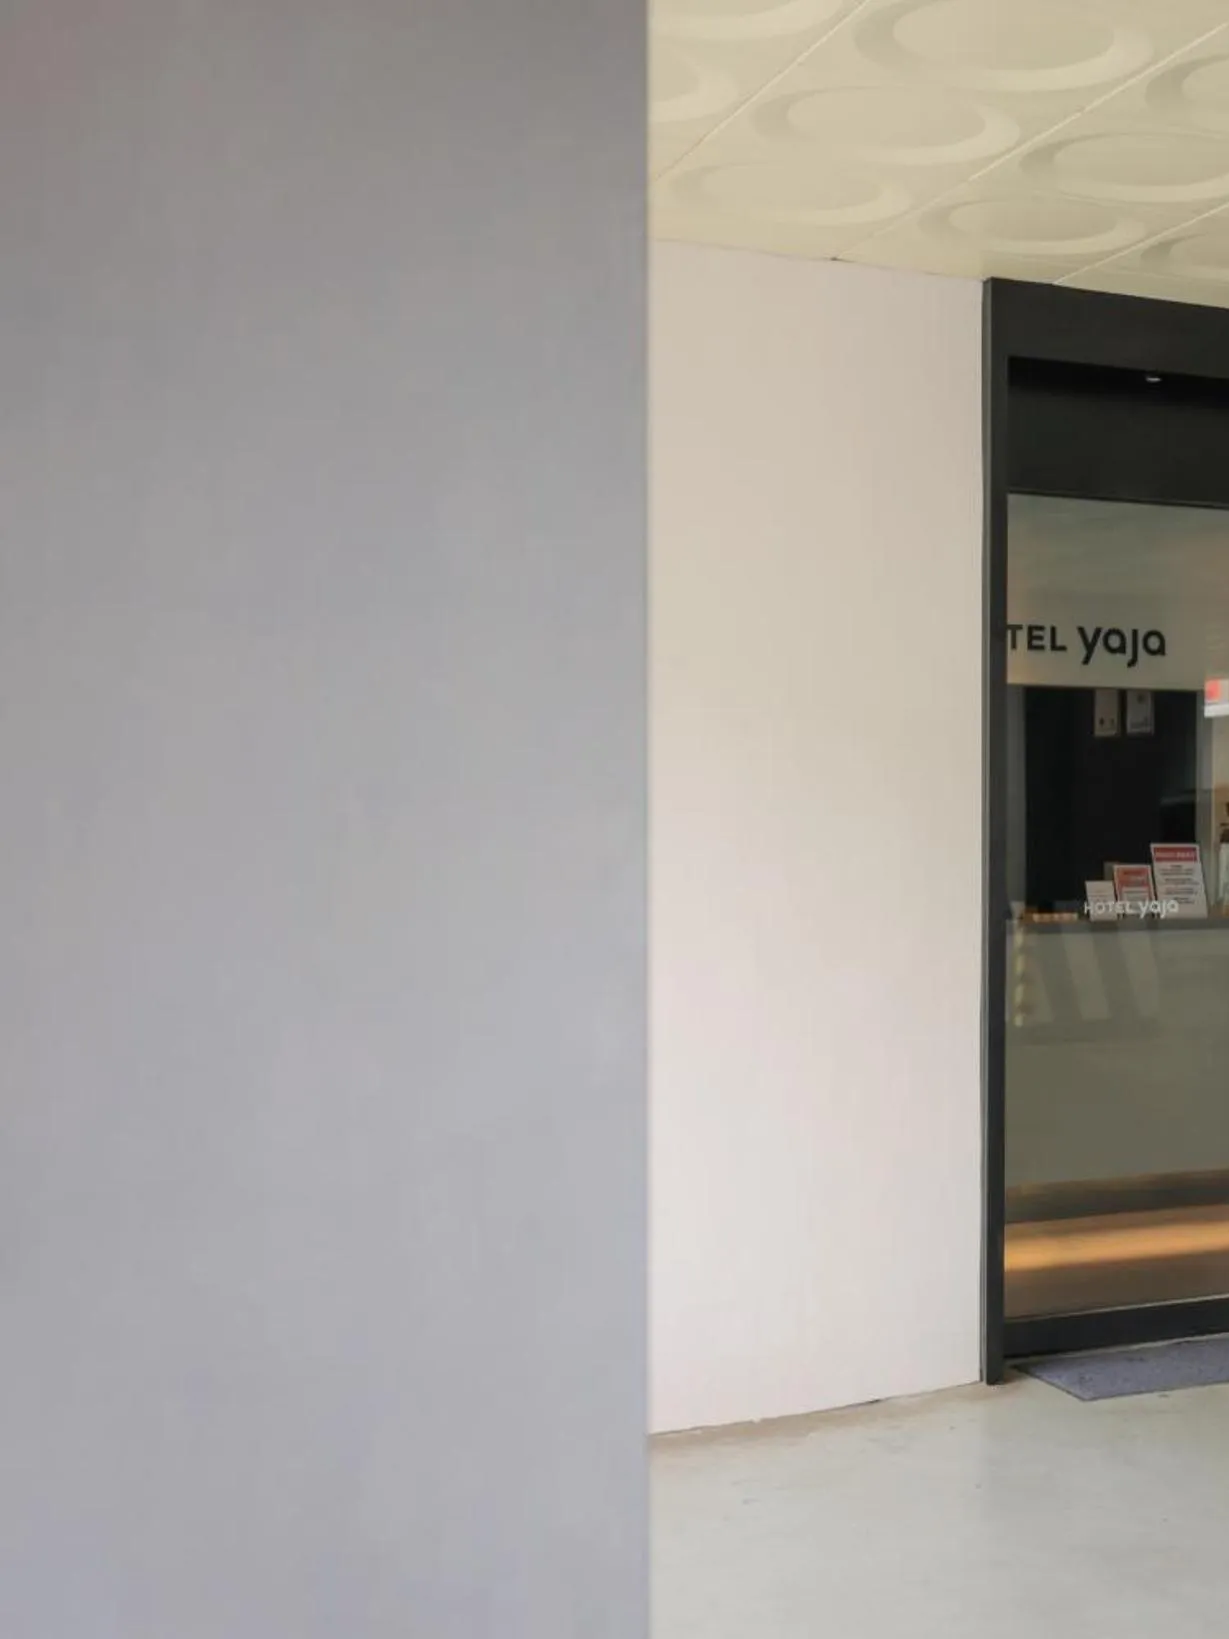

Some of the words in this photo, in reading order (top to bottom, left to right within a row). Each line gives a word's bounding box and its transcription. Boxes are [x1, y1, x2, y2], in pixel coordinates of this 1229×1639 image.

[1006, 624, 1068, 651] TEL
[1076, 625, 1166, 668] yaja
[1084, 900, 1134, 915] HOTEL
[1138, 898, 1179, 919] yaja
